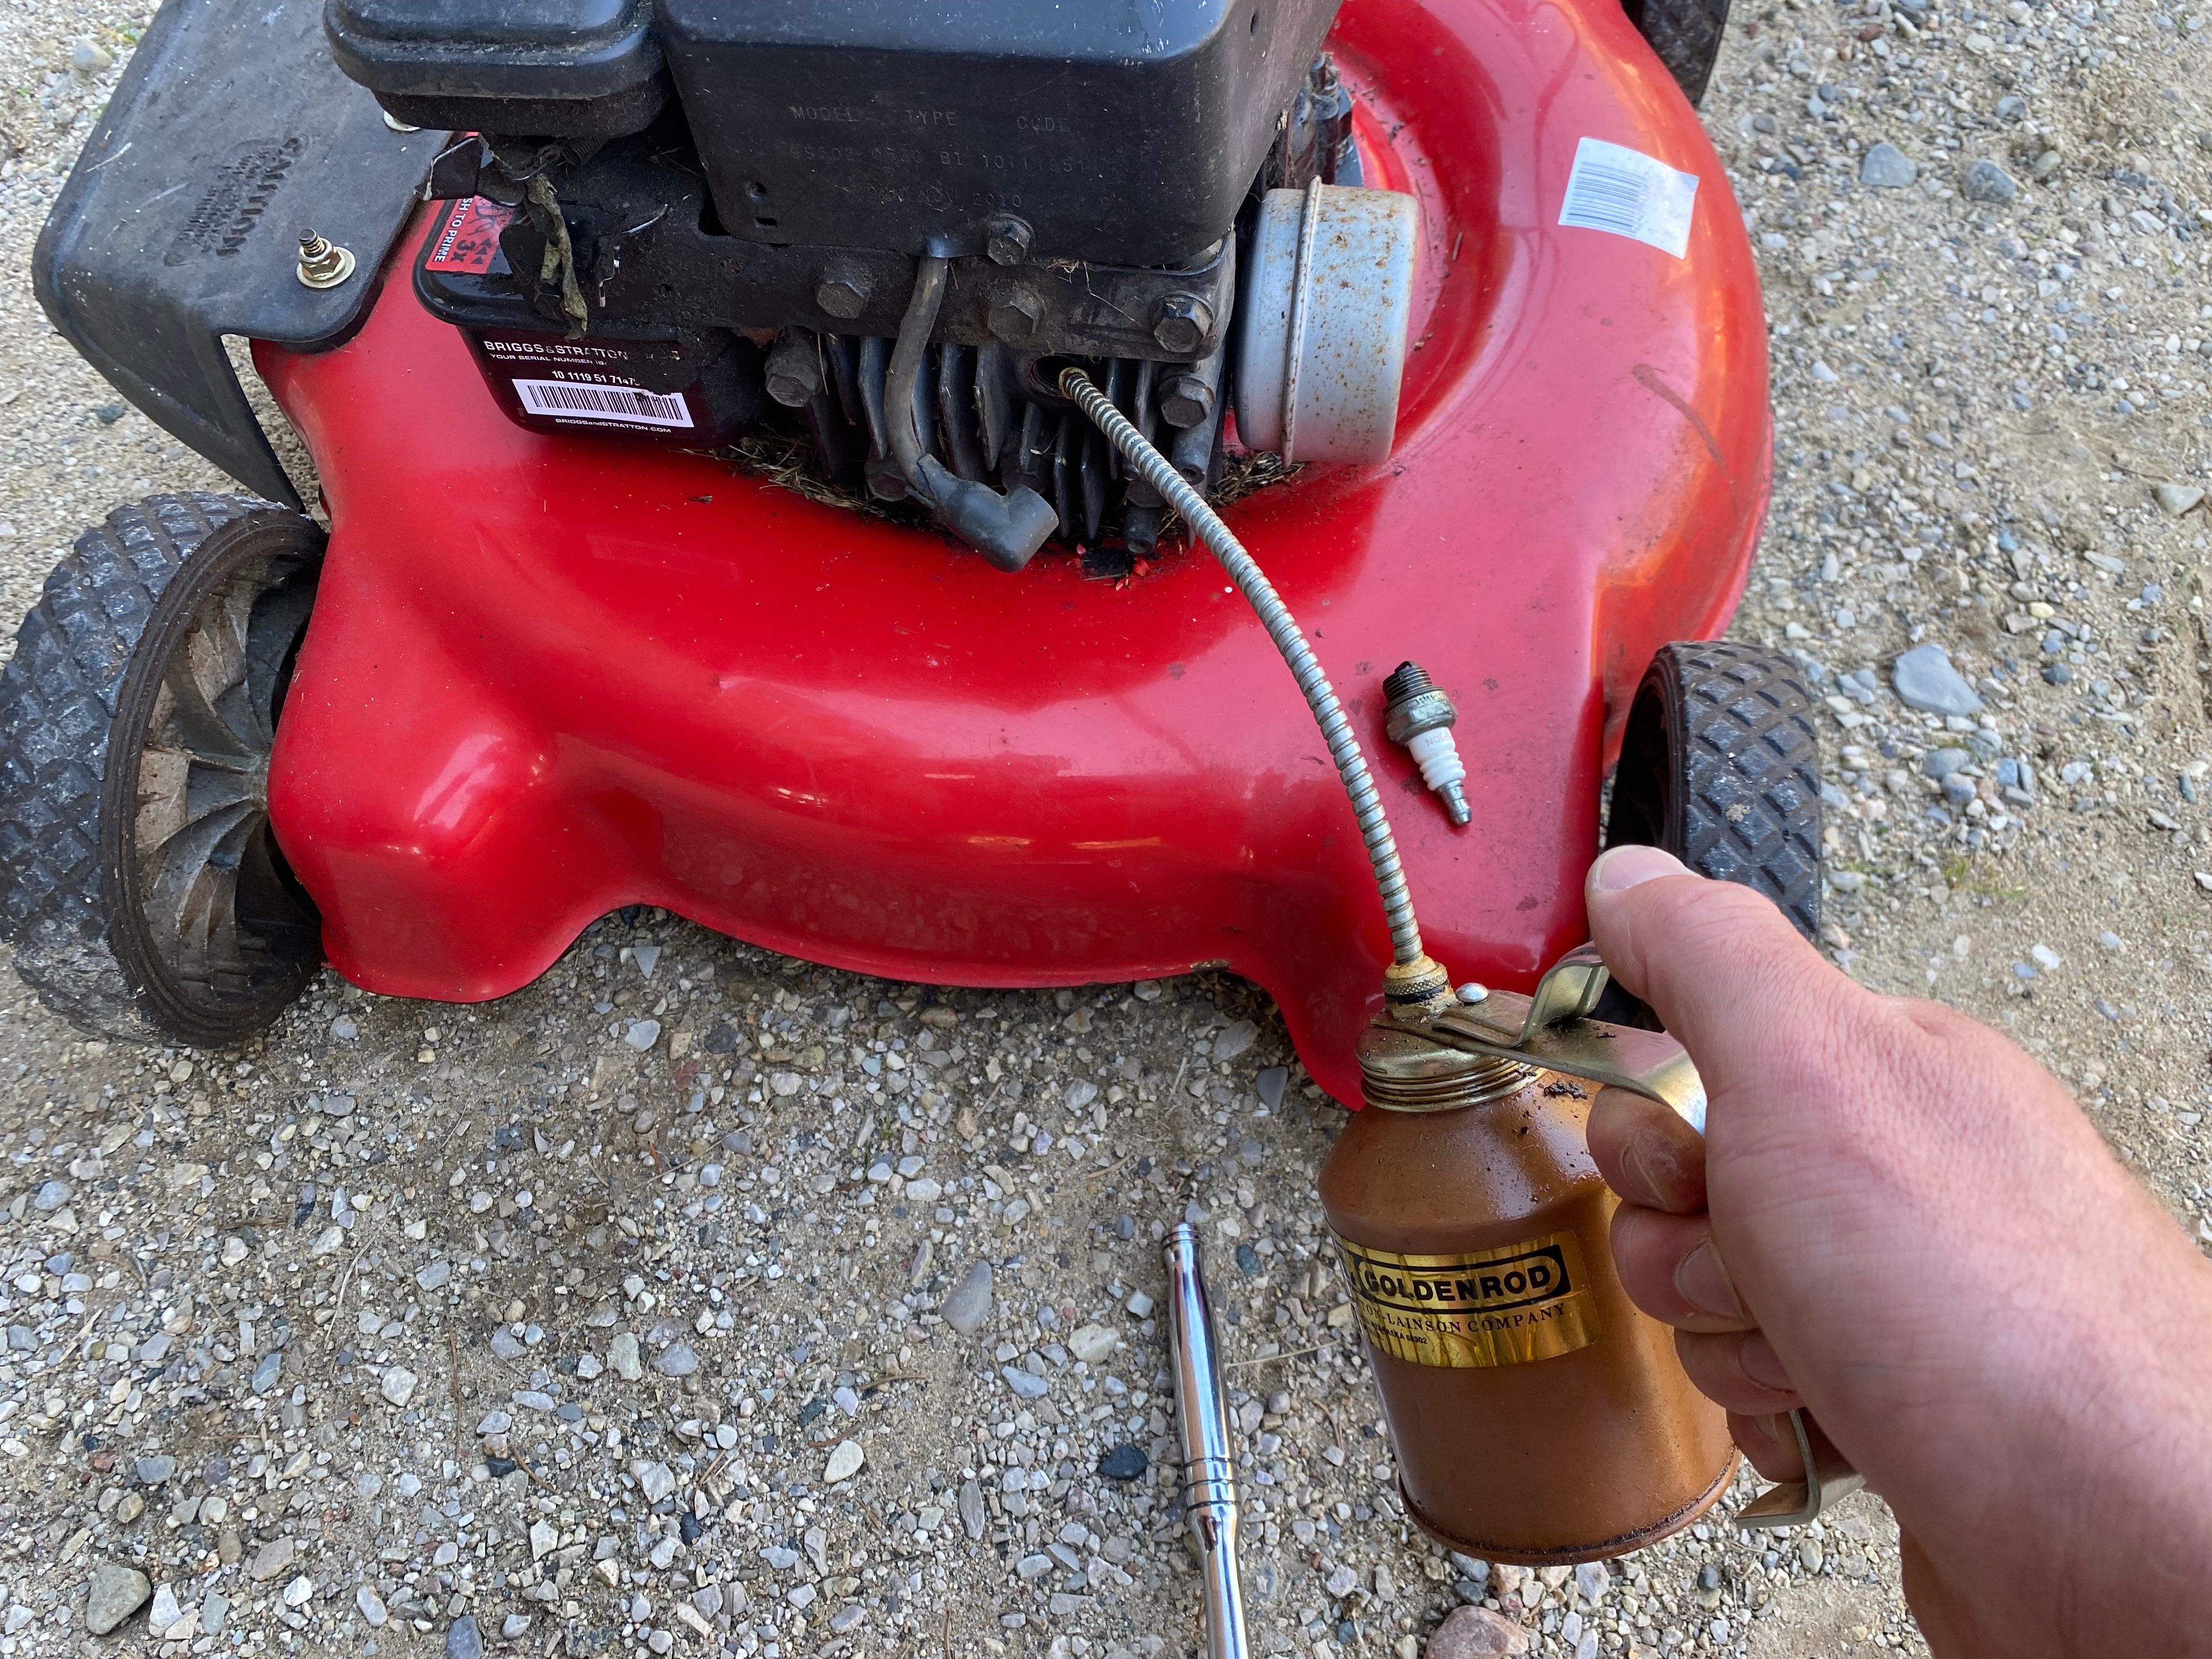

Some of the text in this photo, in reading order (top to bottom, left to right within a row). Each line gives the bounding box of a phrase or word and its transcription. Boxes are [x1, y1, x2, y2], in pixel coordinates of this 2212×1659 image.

[788, 106, 859, 122] MODEL
[905, 110, 958, 126] TYPE
[452, 213, 466, 228] TO
[434, 230, 458, 262] PRIME
[554, 357, 593, 365] NUMBER
[551, 370, 565, 380] 10
[567, 371, 592, 382] 1119
[594, 374, 607, 383] 51
[555, 419, 672, 433] BRIGGSandSTRATTON.COM
[1364, 1265, 1551, 1301] GOLDENROD
[1468, 1303, 1565, 1333] COMPANY
